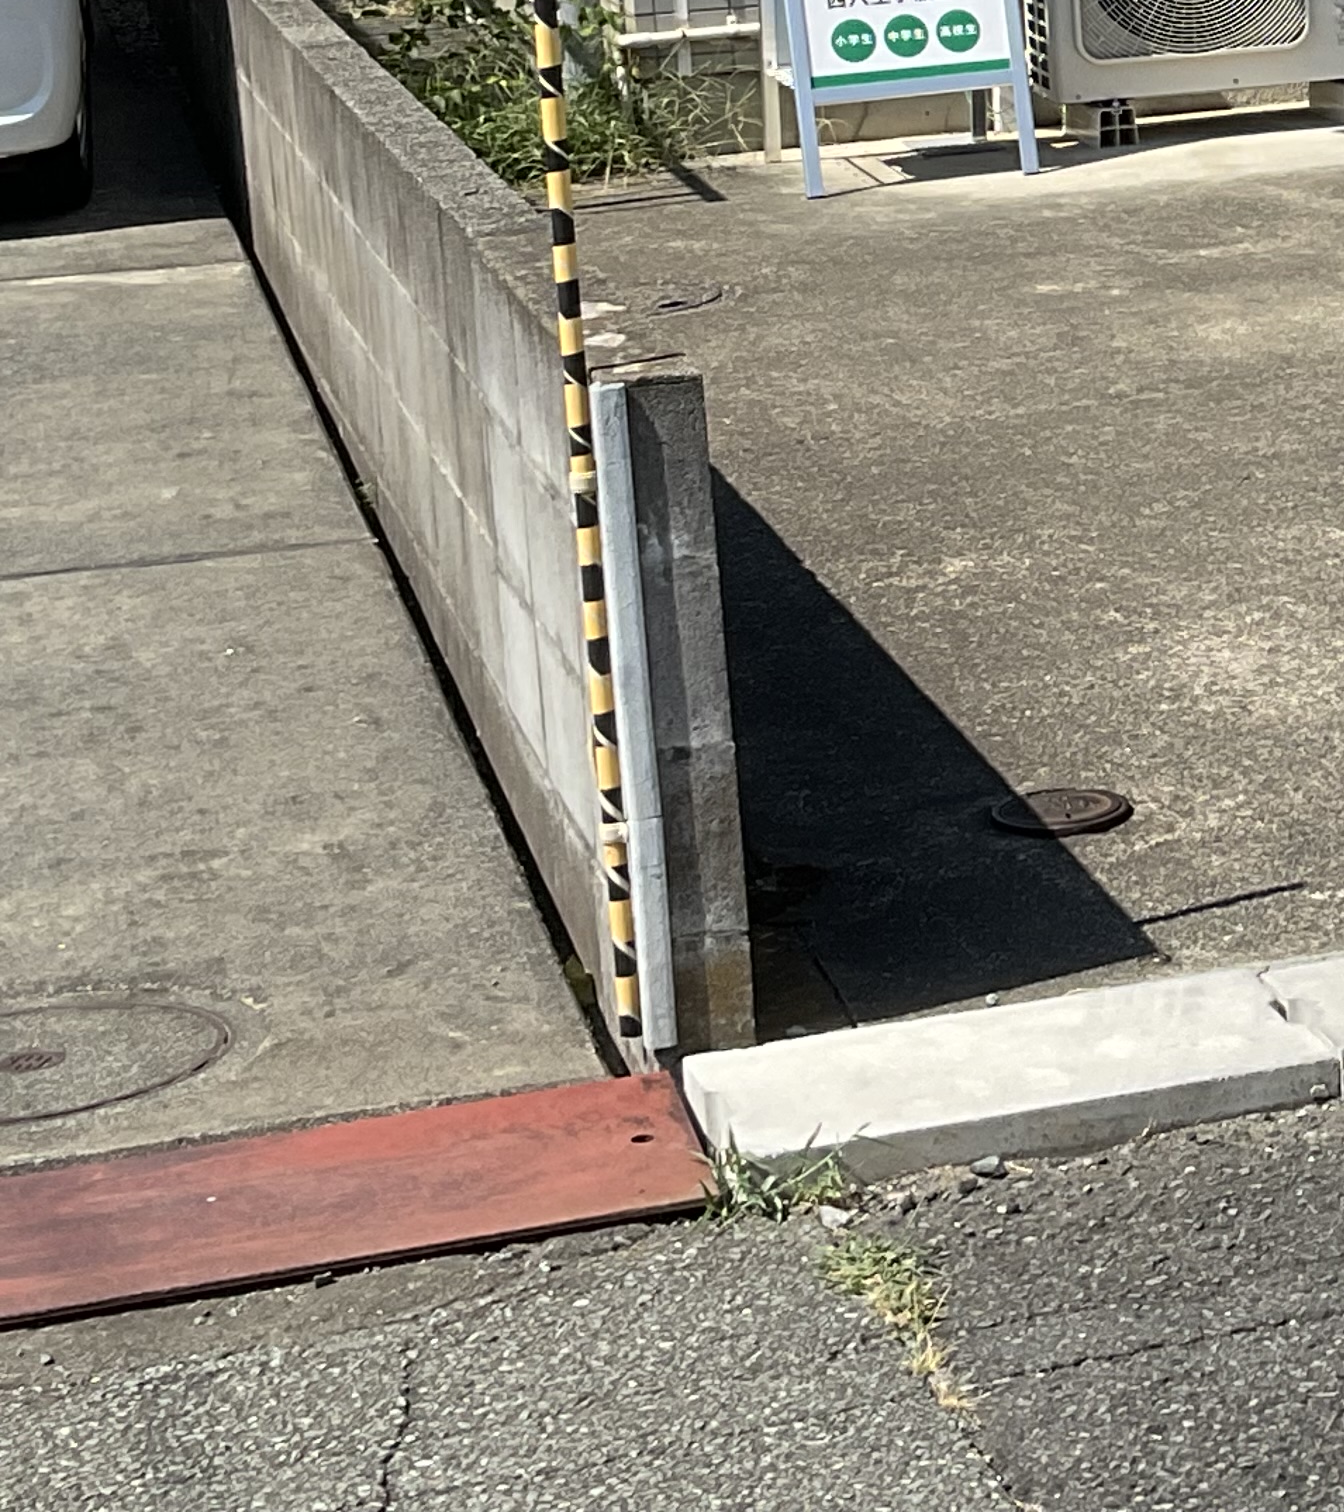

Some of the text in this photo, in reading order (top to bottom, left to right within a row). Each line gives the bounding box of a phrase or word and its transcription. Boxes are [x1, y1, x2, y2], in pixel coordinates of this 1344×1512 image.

[834, 23, 978, 48] 小学生 中学生 高校生
